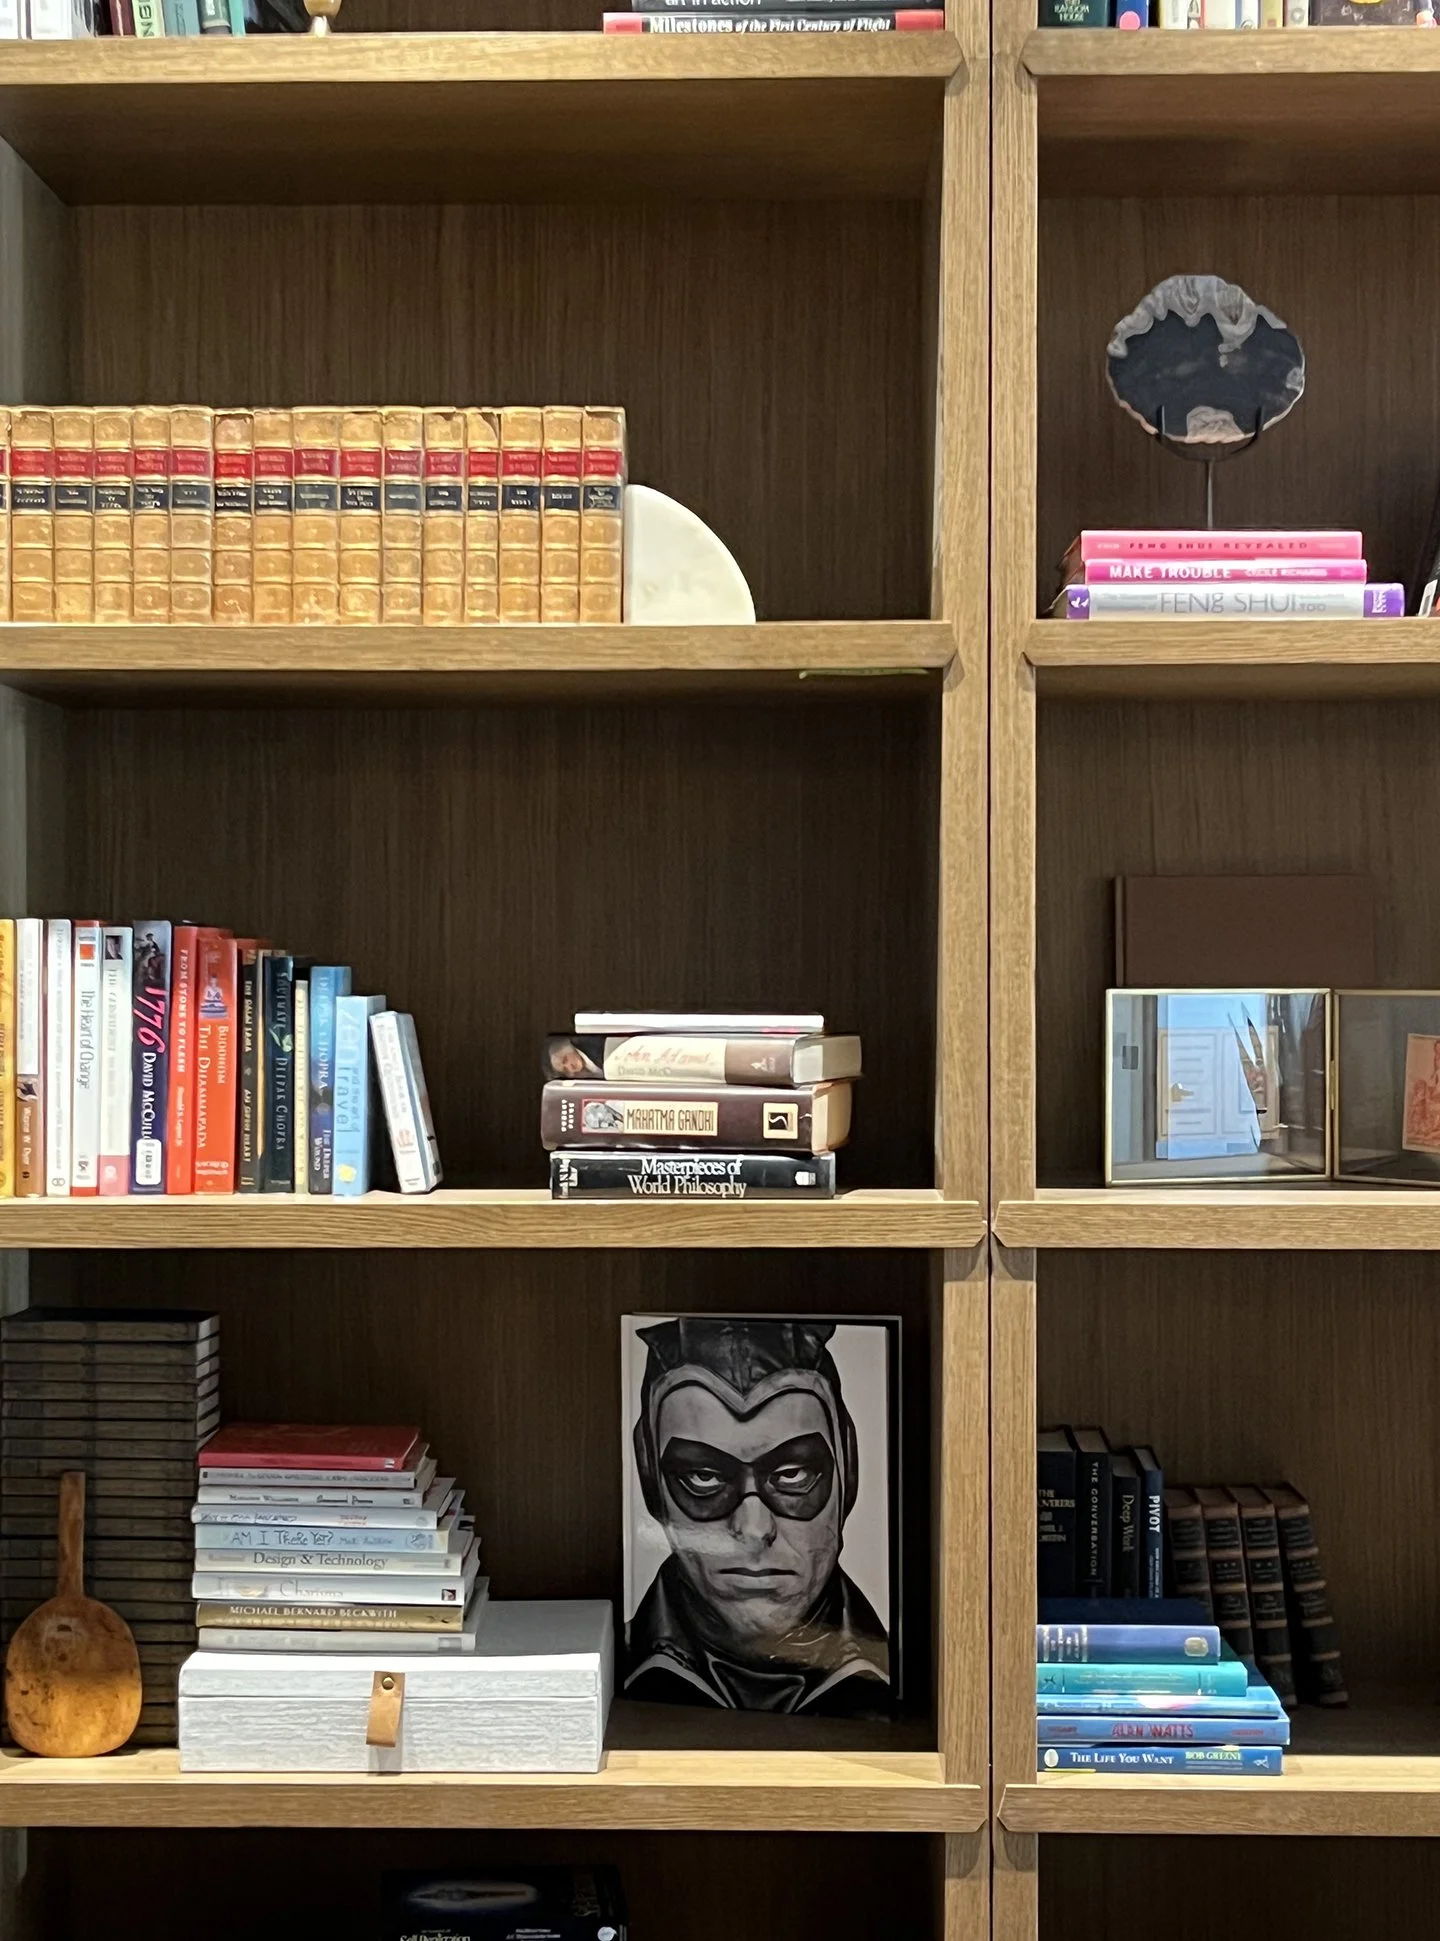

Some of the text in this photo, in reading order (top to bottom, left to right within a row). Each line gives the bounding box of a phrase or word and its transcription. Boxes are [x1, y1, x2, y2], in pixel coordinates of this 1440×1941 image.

[649, 17, 891, 35] Milestones of the First Century of Flight
[1223, 542, 1308, 550] REVEALED
[1109, 565, 1153, 580] MAKE
[1160, 565, 1232, 580] TROUBLE
[1235, 592, 1296, 613] SHUI
[132, 986, 169, 1053] 1776
[177, 949, 188, 1073] FROM STONE TO FLESH
[76, 991, 95, 1089] The Heart of Change
[142, 1052, 158, 1086] DAVID
[20, 1107, 32, 1132] Wayne
[275, 1105, 289, 1150] CHOPRA
[626, 1108, 715, 1132] MAHATMA GANDHI
[20, 1147, 32, 1166] Dyer
[641, 1157, 743, 1179] Masterpieces of
[628, 1174, 747, 1198] World Philosophy
[1090, 1461, 1099, 1576] THE CONVERSATION
[1120, 1494, 1135, 1553] Deep Work
[1148, 1495, 1161, 1533] PIVOT
[230, 1531, 252, 1545] AM
[256, 1530, 270, 1545] I
[253, 1552, 388, 1568] Design & Technology
[230, 1606, 397, 1619] MICHAEL BERNARD BECKWITH
[1112, 1723, 1194, 1739] ALAN WATTS
[1070, 1752, 1092, 1763] THE
[1094, 1753, 1116, 1764] LIFE
[1118, 1753, 1140, 1764] YOU
[1142, 1753, 1174, 1765] WANT
[1185, 1751, 1205, 1760] BOB
